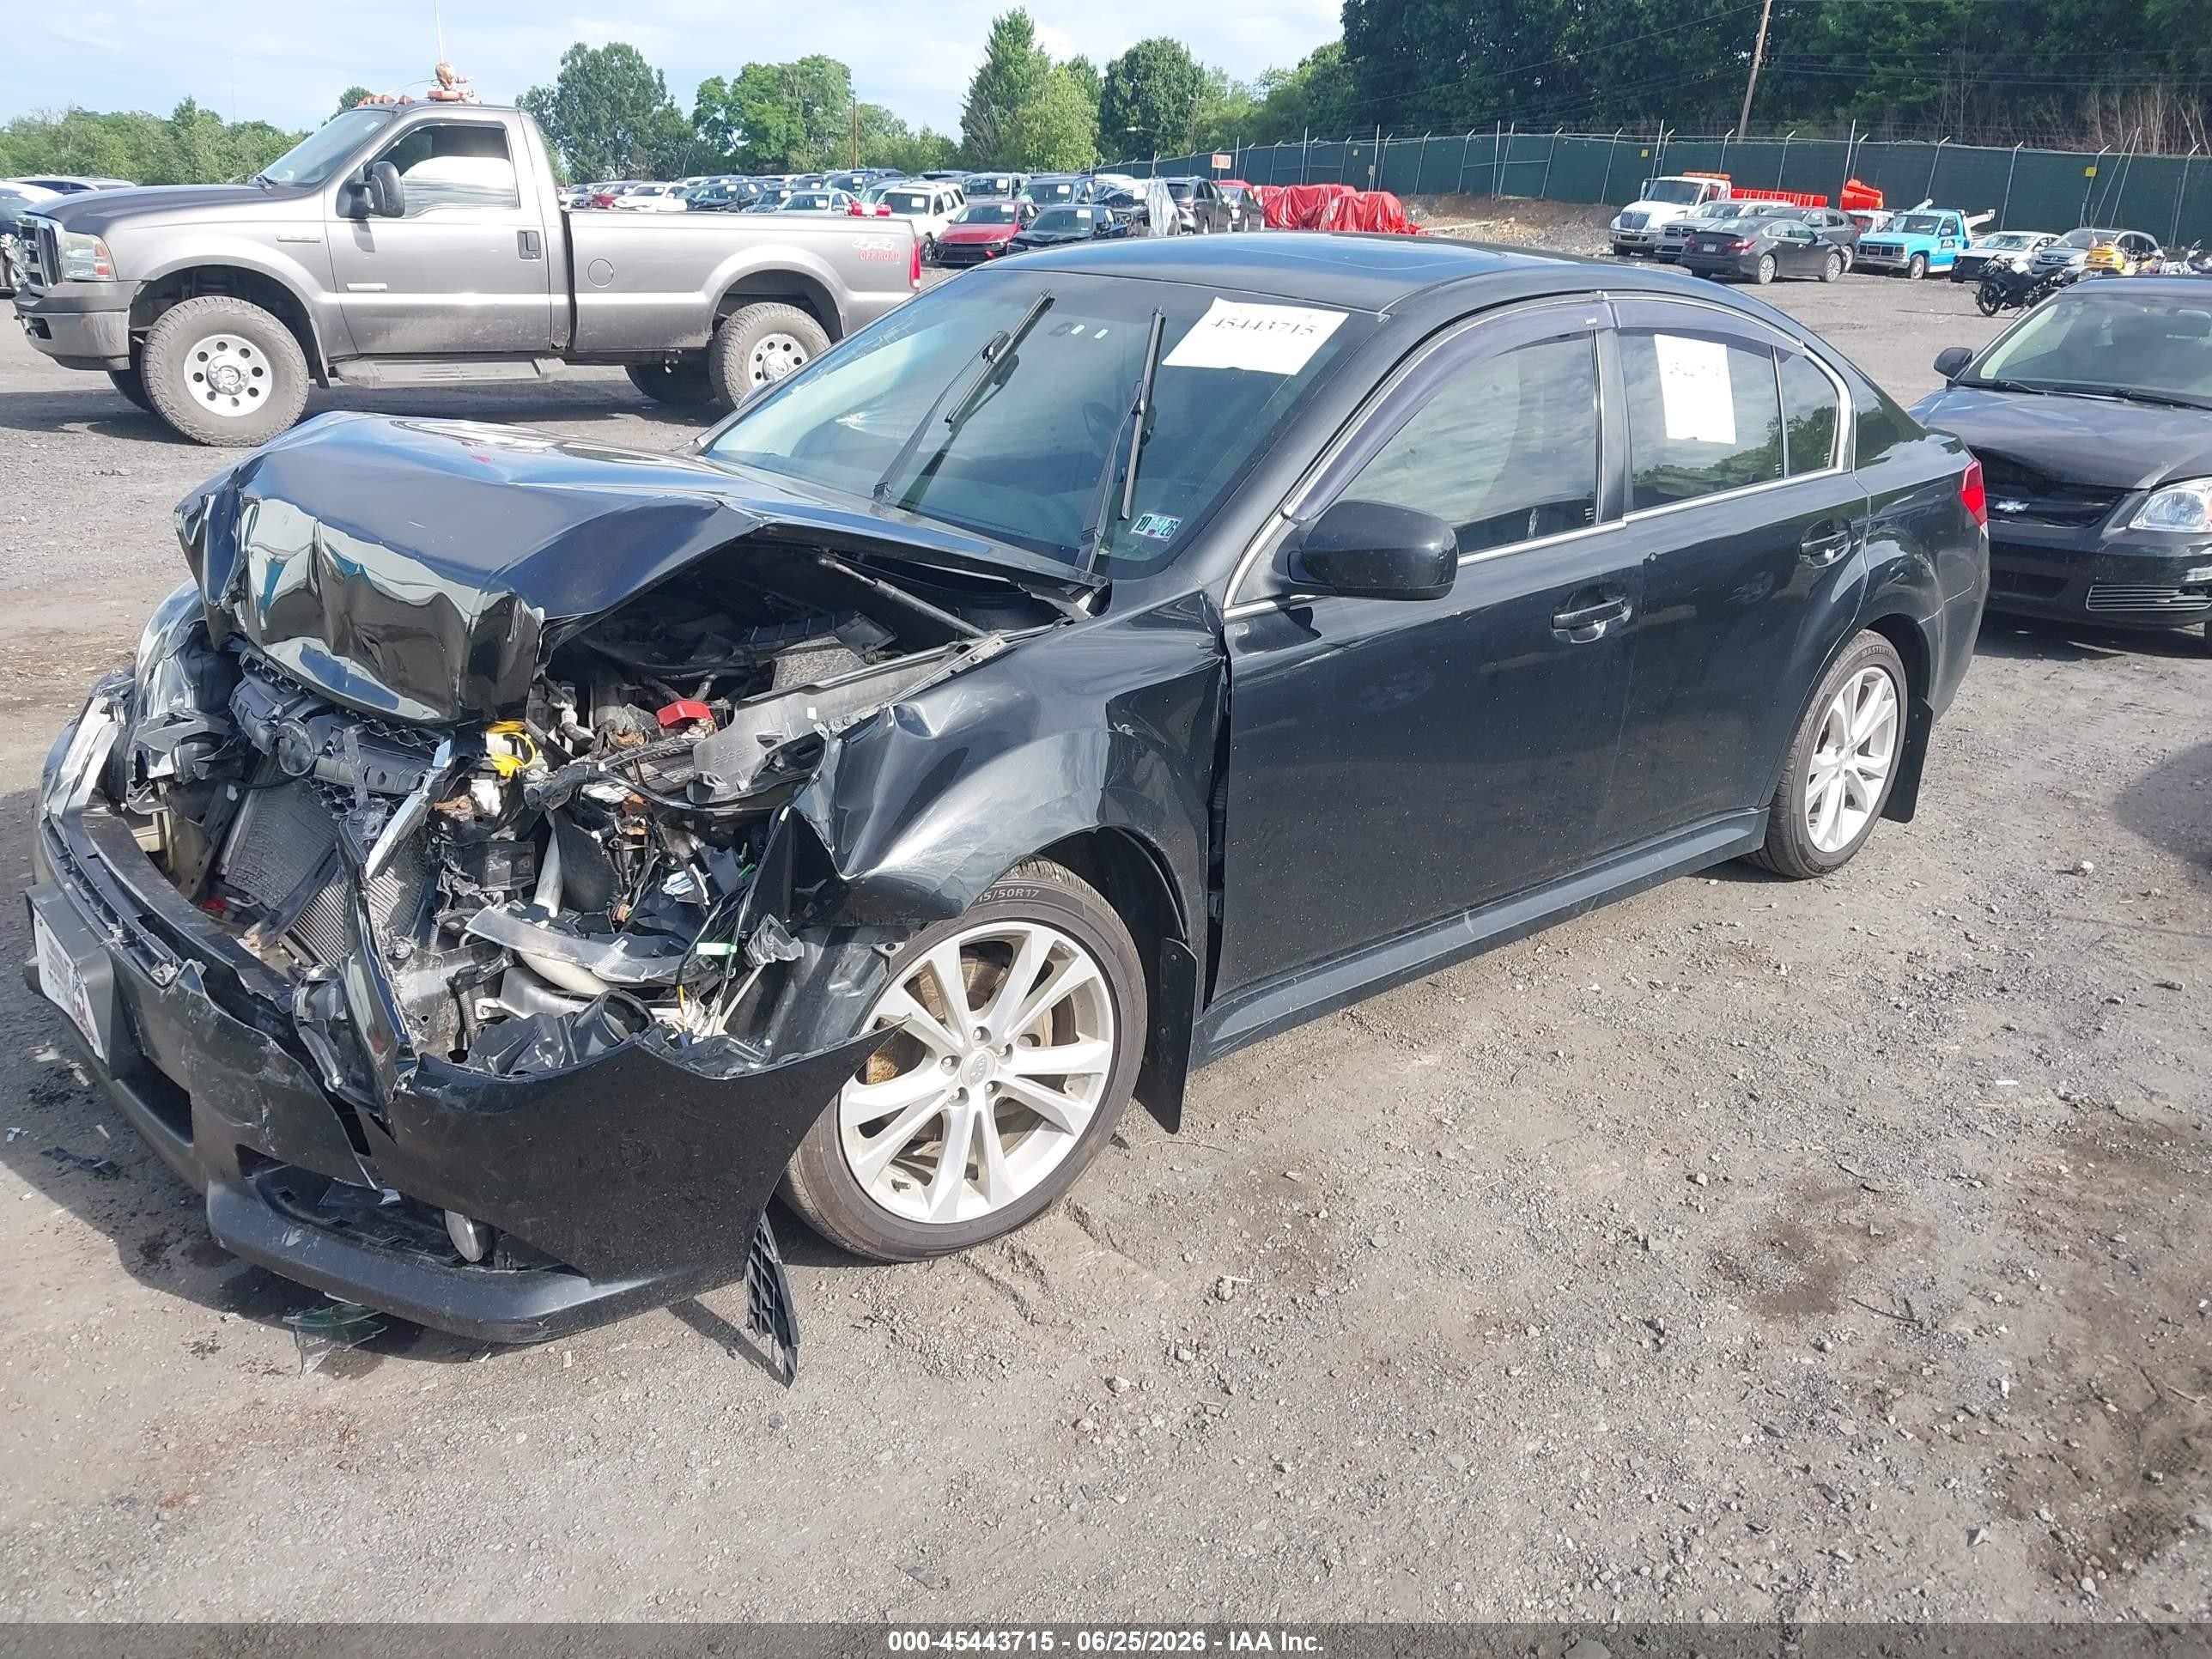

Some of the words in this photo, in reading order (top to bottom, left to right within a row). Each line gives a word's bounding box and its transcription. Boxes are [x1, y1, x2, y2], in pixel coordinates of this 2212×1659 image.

[860, 250, 876, 261] OFF
[878, 250, 901, 261] ROAD
[1134, 514, 1153, 532] 10
[1160, 520, 1179, 537] 26
[978, 888, 1040, 902] 15/50R17
